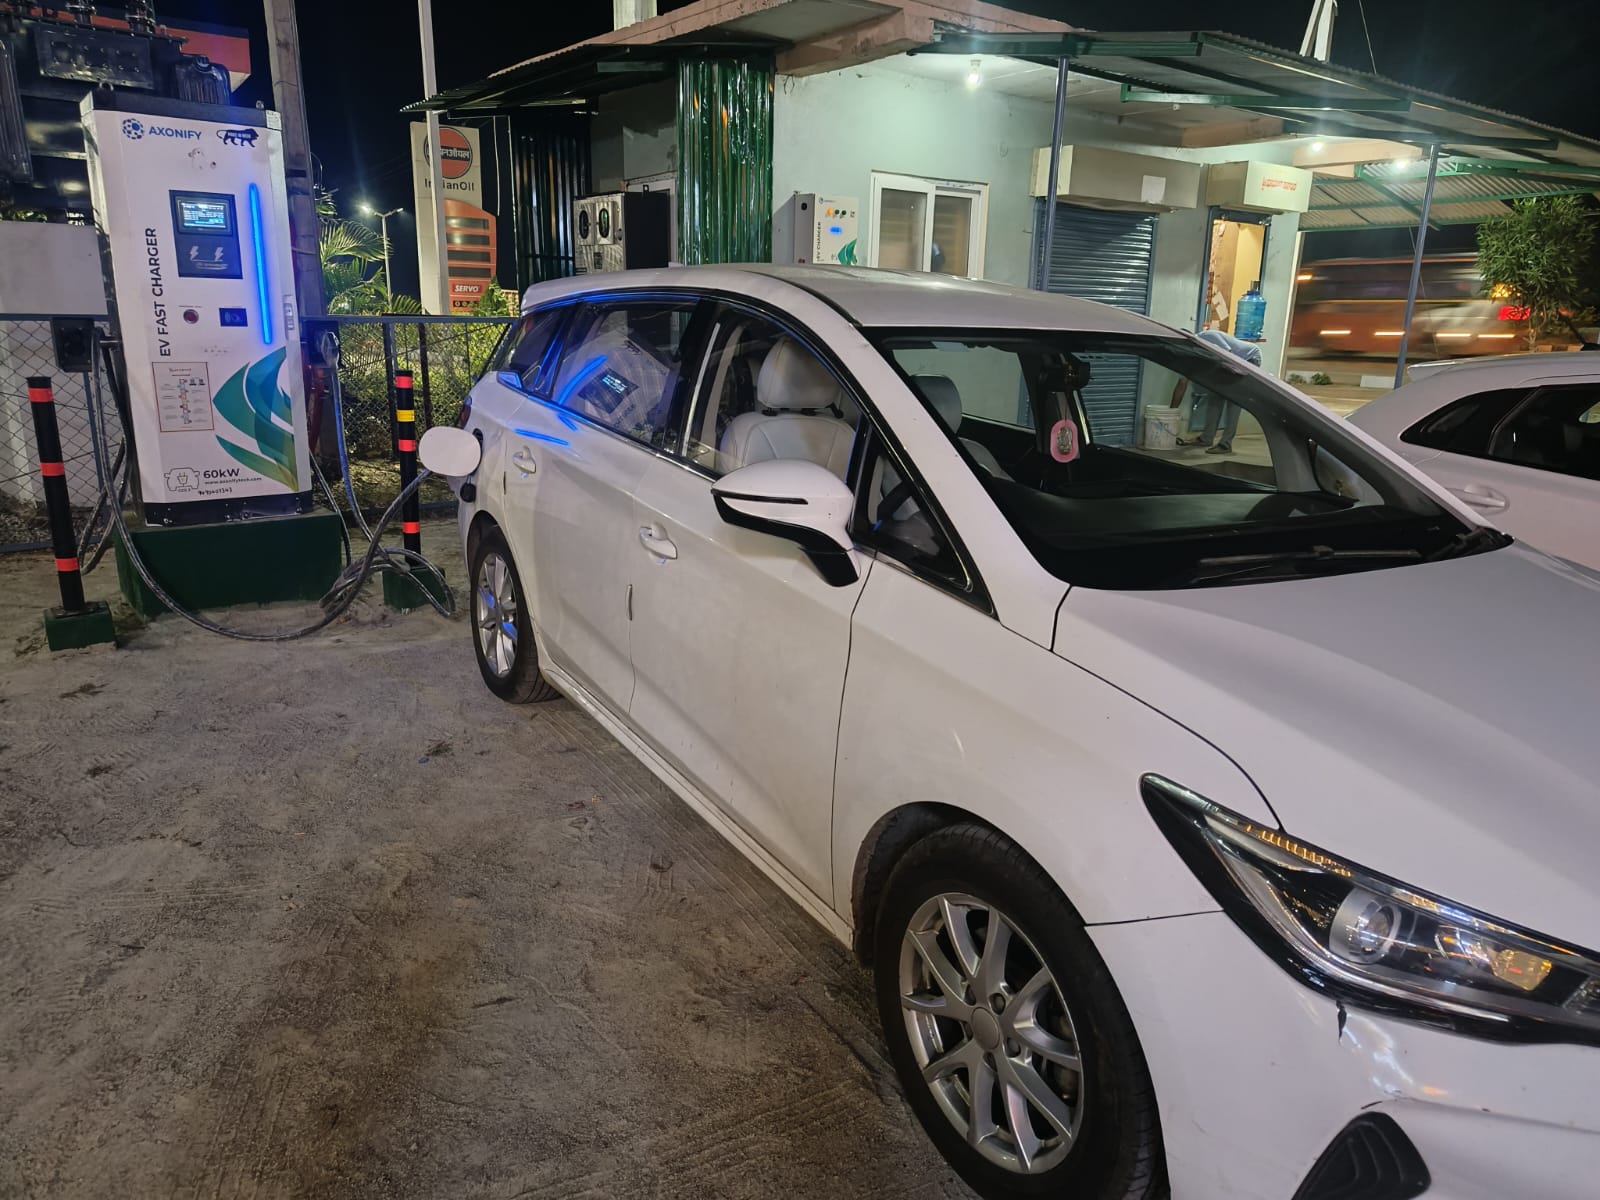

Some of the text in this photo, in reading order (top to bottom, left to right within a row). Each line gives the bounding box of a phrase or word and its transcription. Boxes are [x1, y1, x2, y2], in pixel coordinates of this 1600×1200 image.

[148, 126, 202, 140] AXONIFY
[424, 178, 475, 191] IianOil
[145, 227, 171, 356] EV FAST CHARGER
[454, 285, 479, 293] SERVO
[203, 468, 240, 479] 60kW
